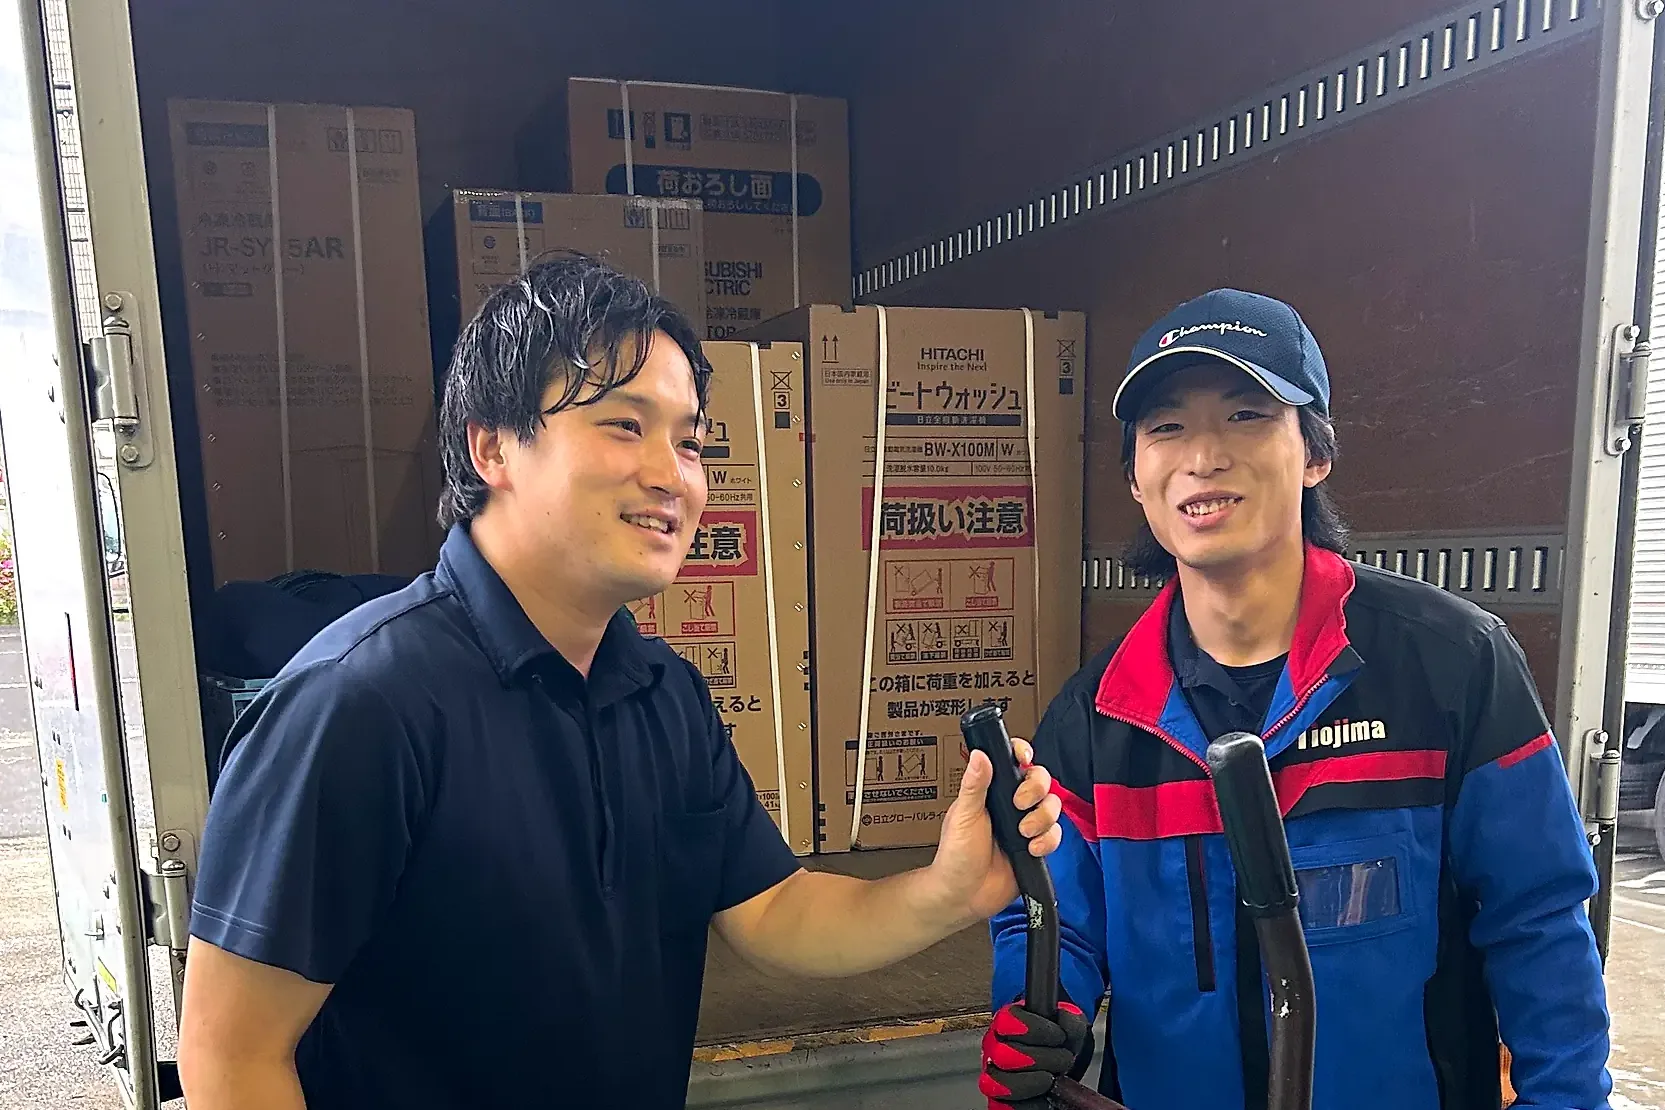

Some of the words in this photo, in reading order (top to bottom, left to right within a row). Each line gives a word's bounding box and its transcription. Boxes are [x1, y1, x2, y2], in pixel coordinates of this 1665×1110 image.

[656, 169, 775, 200] 荷おろし面
[201, 236, 345, 259] JR-SY5AR
[704, 261, 763, 280] UBISHI
[1158, 320, 1268, 348] Champion
[920, 347, 985, 361] HITACHI
[917, 362, 947, 373] Inspire
[950, 363, 964, 371] the
[1062, 360, 1072, 374] 3
[776, 395, 787, 408] 3
[924, 441, 995, 458] BW-X100M
[1001, 443, 1015, 456] W
[711, 470, 727, 485] W
[880, 500, 1024, 536] 荷扱い注意
[870, 670, 1036, 693] この箱に荷重を加えると
[873, 810, 947, 824] 日立グローバルライ
